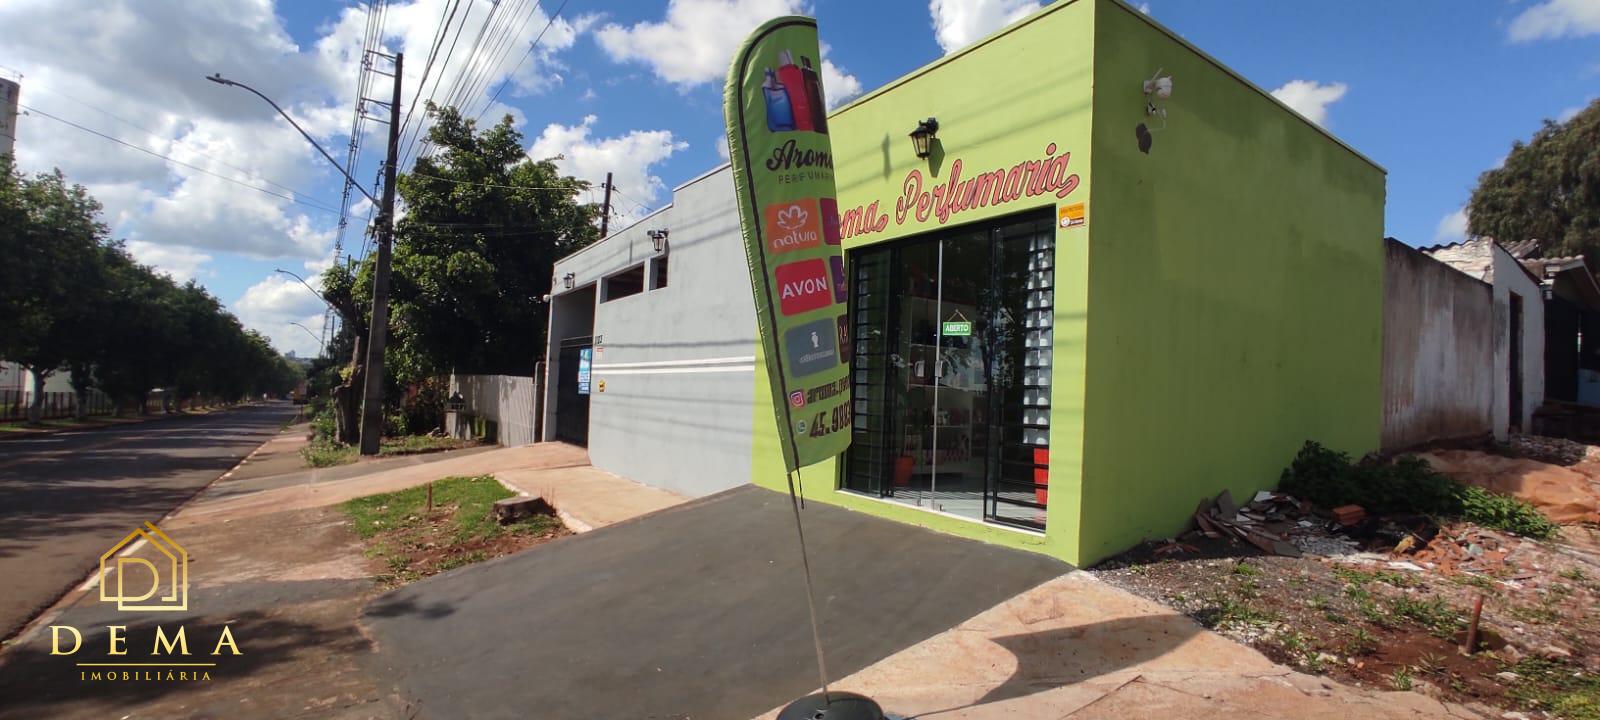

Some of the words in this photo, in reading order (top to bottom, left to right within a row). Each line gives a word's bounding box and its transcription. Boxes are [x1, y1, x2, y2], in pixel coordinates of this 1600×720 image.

[896, 143, 1080, 225] Perfumaria
[773, 230, 817, 249] natura
[782, 276, 829, 300] AVON
[945, 324, 969, 332] ABERTO
